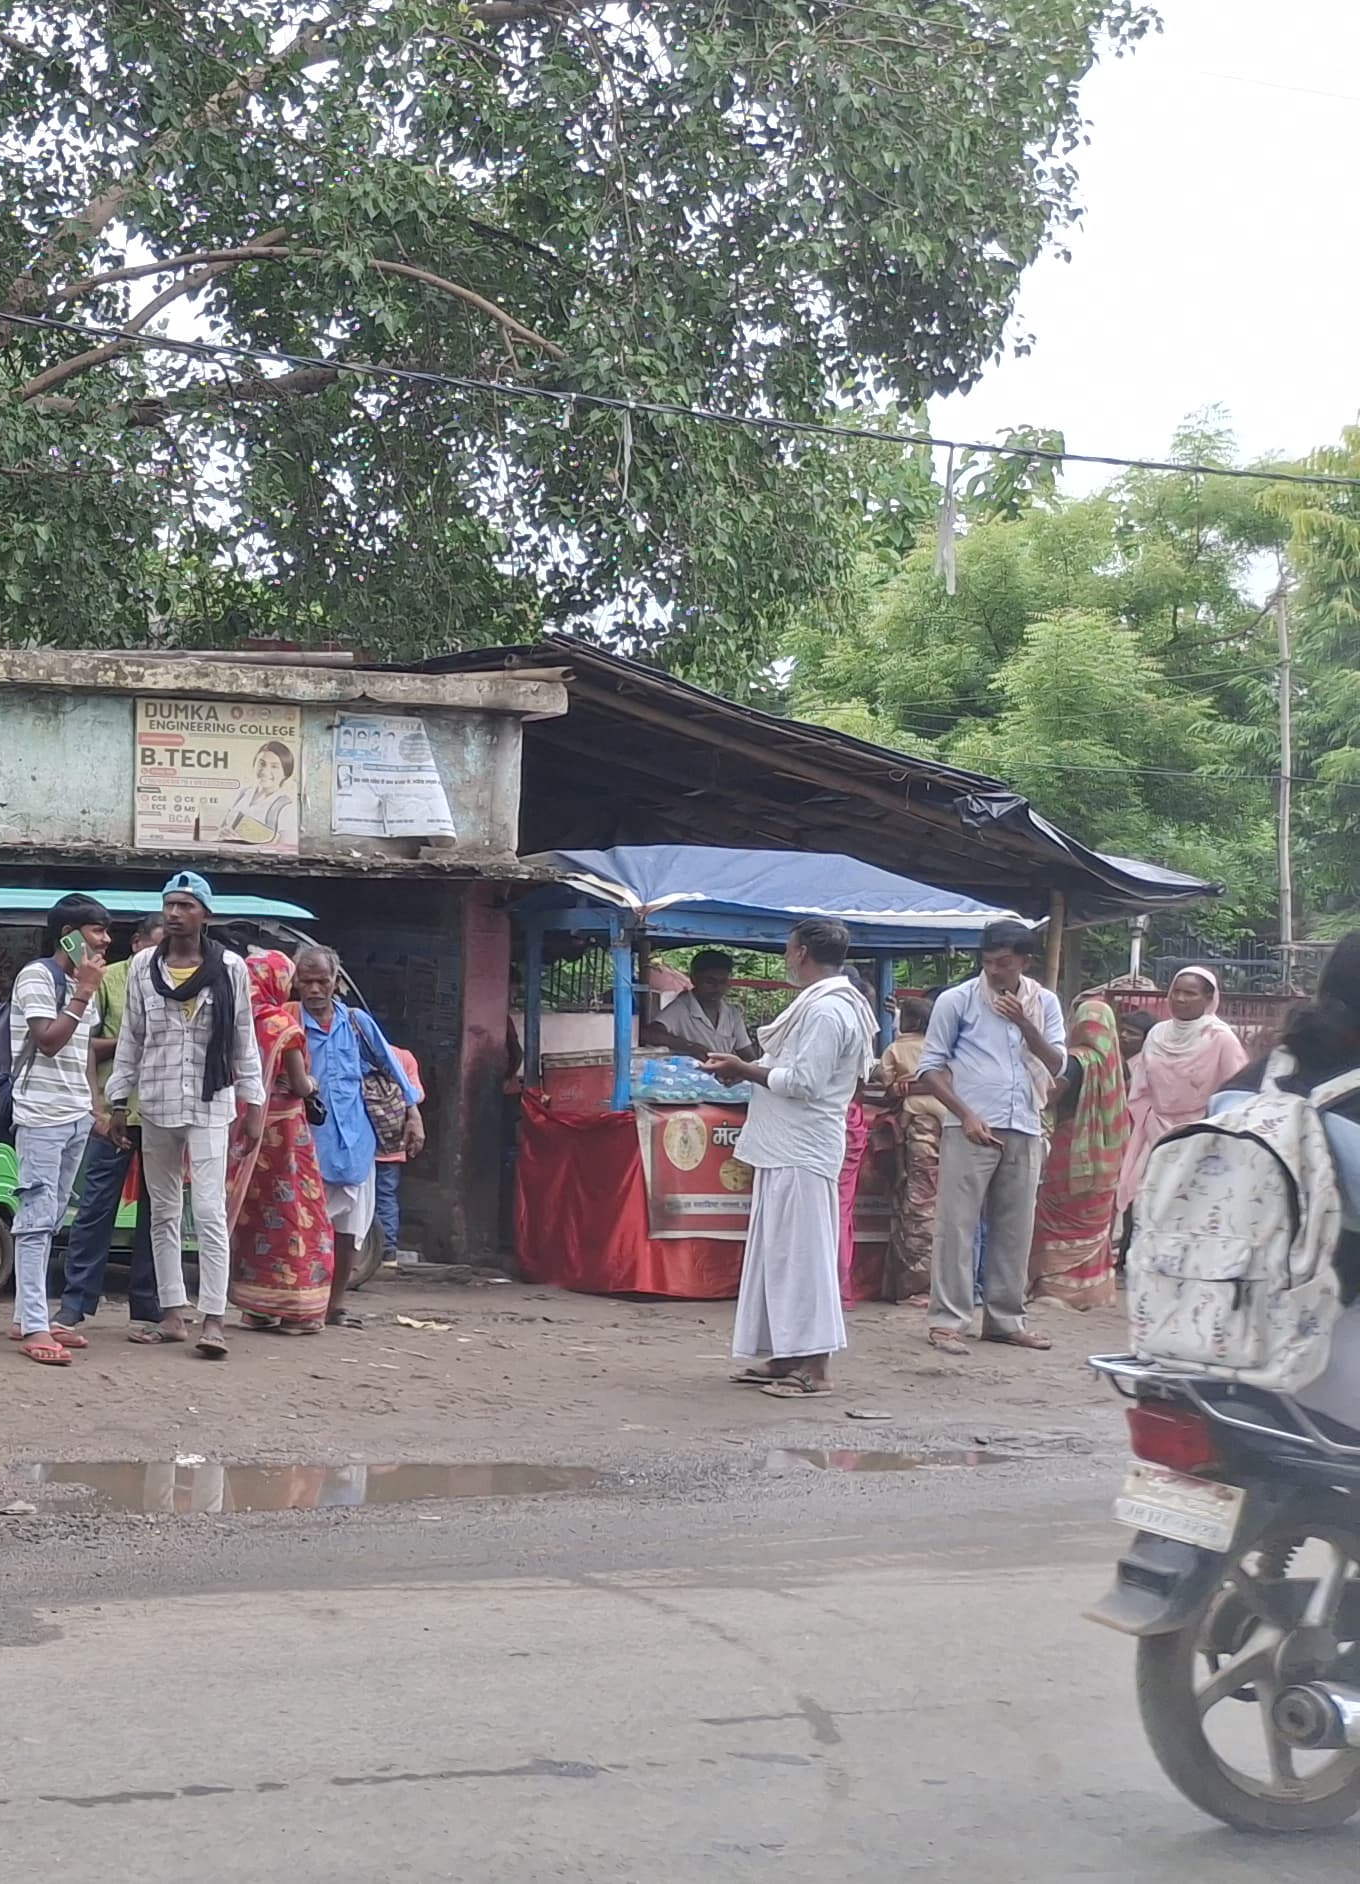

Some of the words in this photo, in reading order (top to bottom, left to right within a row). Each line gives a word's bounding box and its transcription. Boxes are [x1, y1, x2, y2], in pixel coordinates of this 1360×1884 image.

[144, 702, 220, 721] DUMKA
[149, 719, 236, 734] ENGINEERING
[239, 724, 296, 737] COLLEGE
[140, 748, 229, 769] B.TECH
